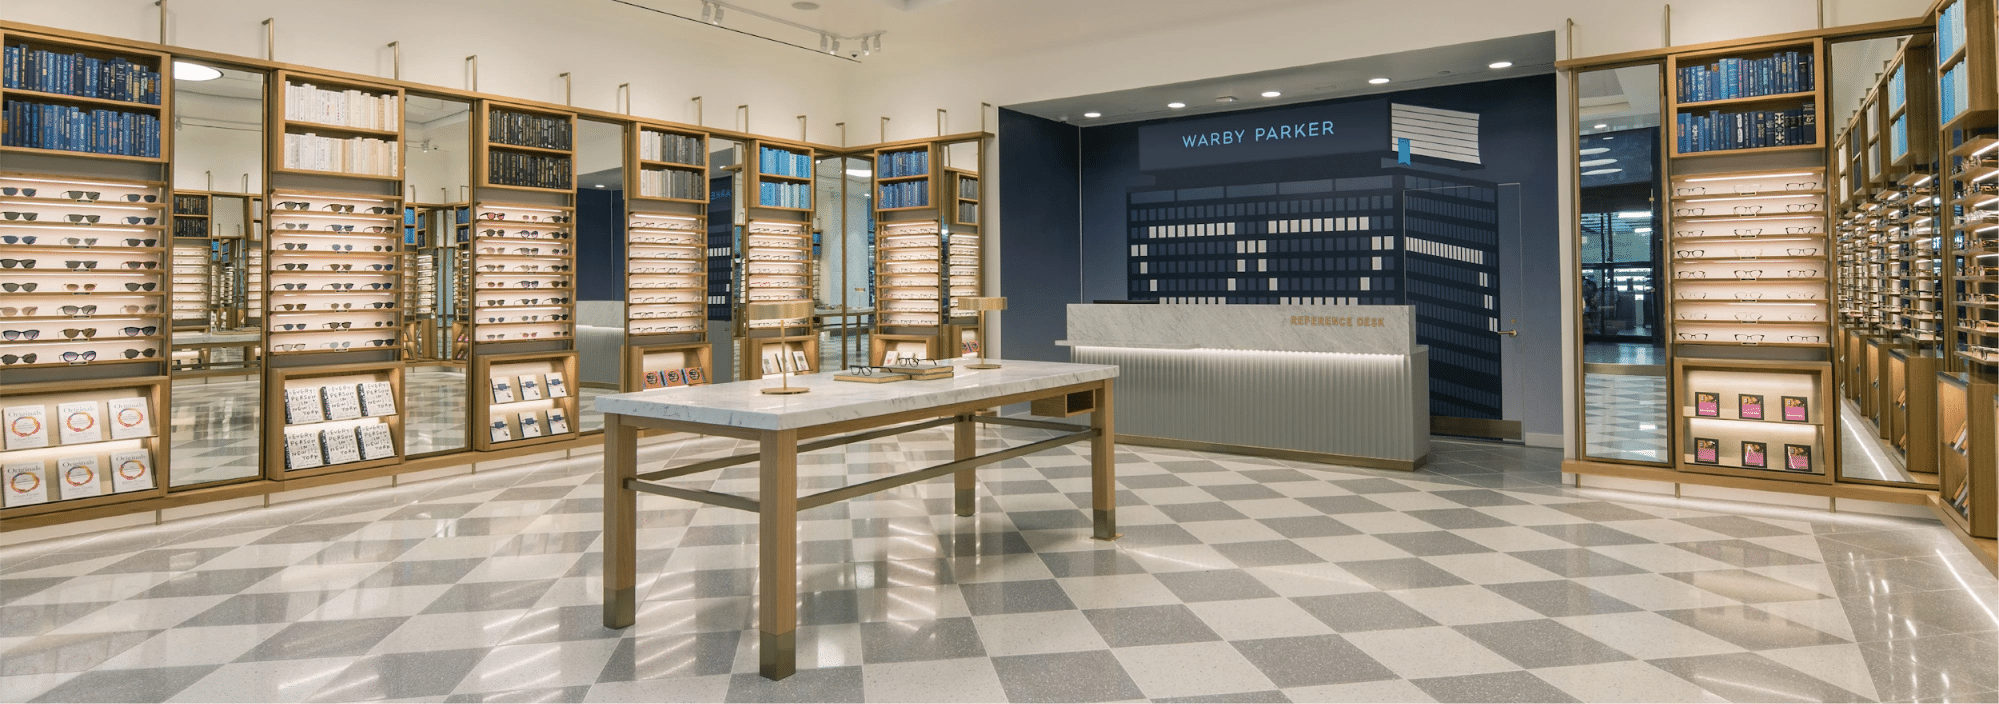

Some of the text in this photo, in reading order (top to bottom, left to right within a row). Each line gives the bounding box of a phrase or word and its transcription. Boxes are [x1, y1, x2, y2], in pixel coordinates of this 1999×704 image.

[1182, 120, 1334, 148] WARBY PARKER
[1290, 315, 1385, 328] REFERENCE DESK
[116, 454, 146, 462] Originals
[62, 460, 94, 468] Originals
[8, 466, 41, 474] Originals
